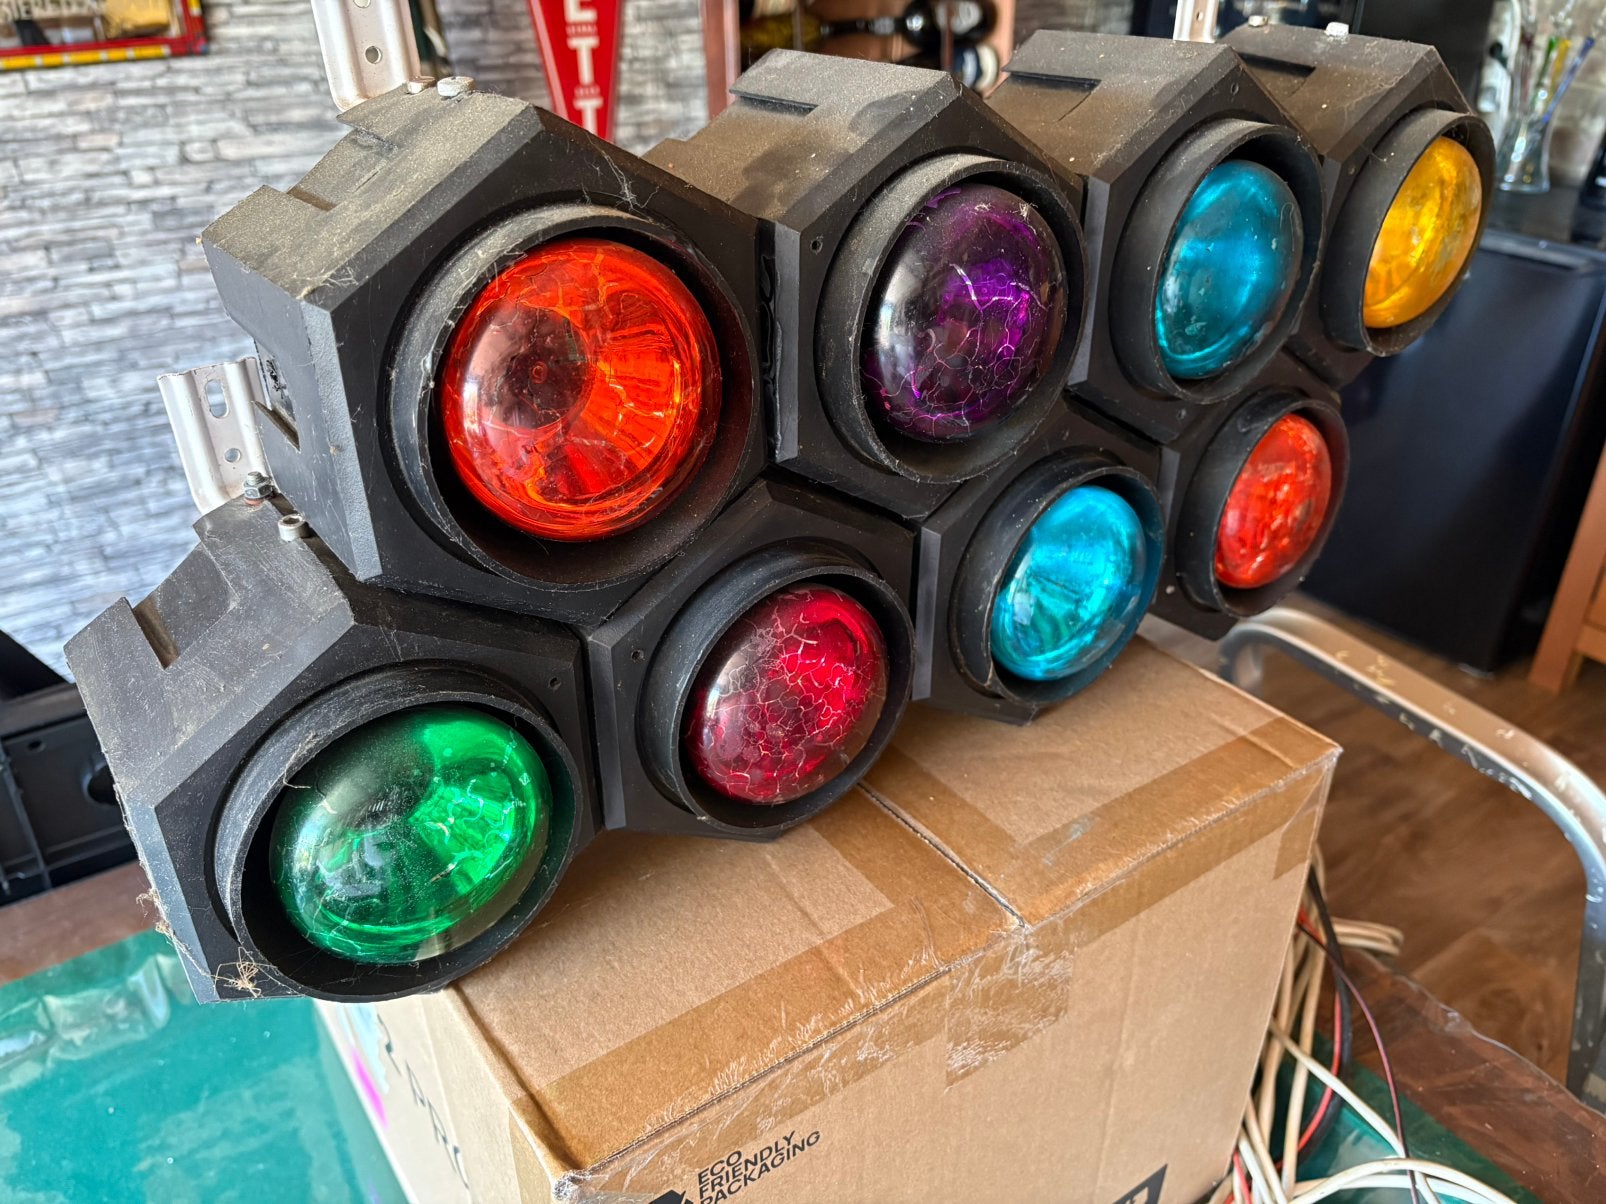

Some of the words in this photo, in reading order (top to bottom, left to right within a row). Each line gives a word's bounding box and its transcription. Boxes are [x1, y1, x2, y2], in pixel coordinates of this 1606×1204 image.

[698, 1150, 742, 1186] ECO
[699, 1130, 796, 1200] FRIENDLY
[700, 1131, 820, 1204] PACKAGING
